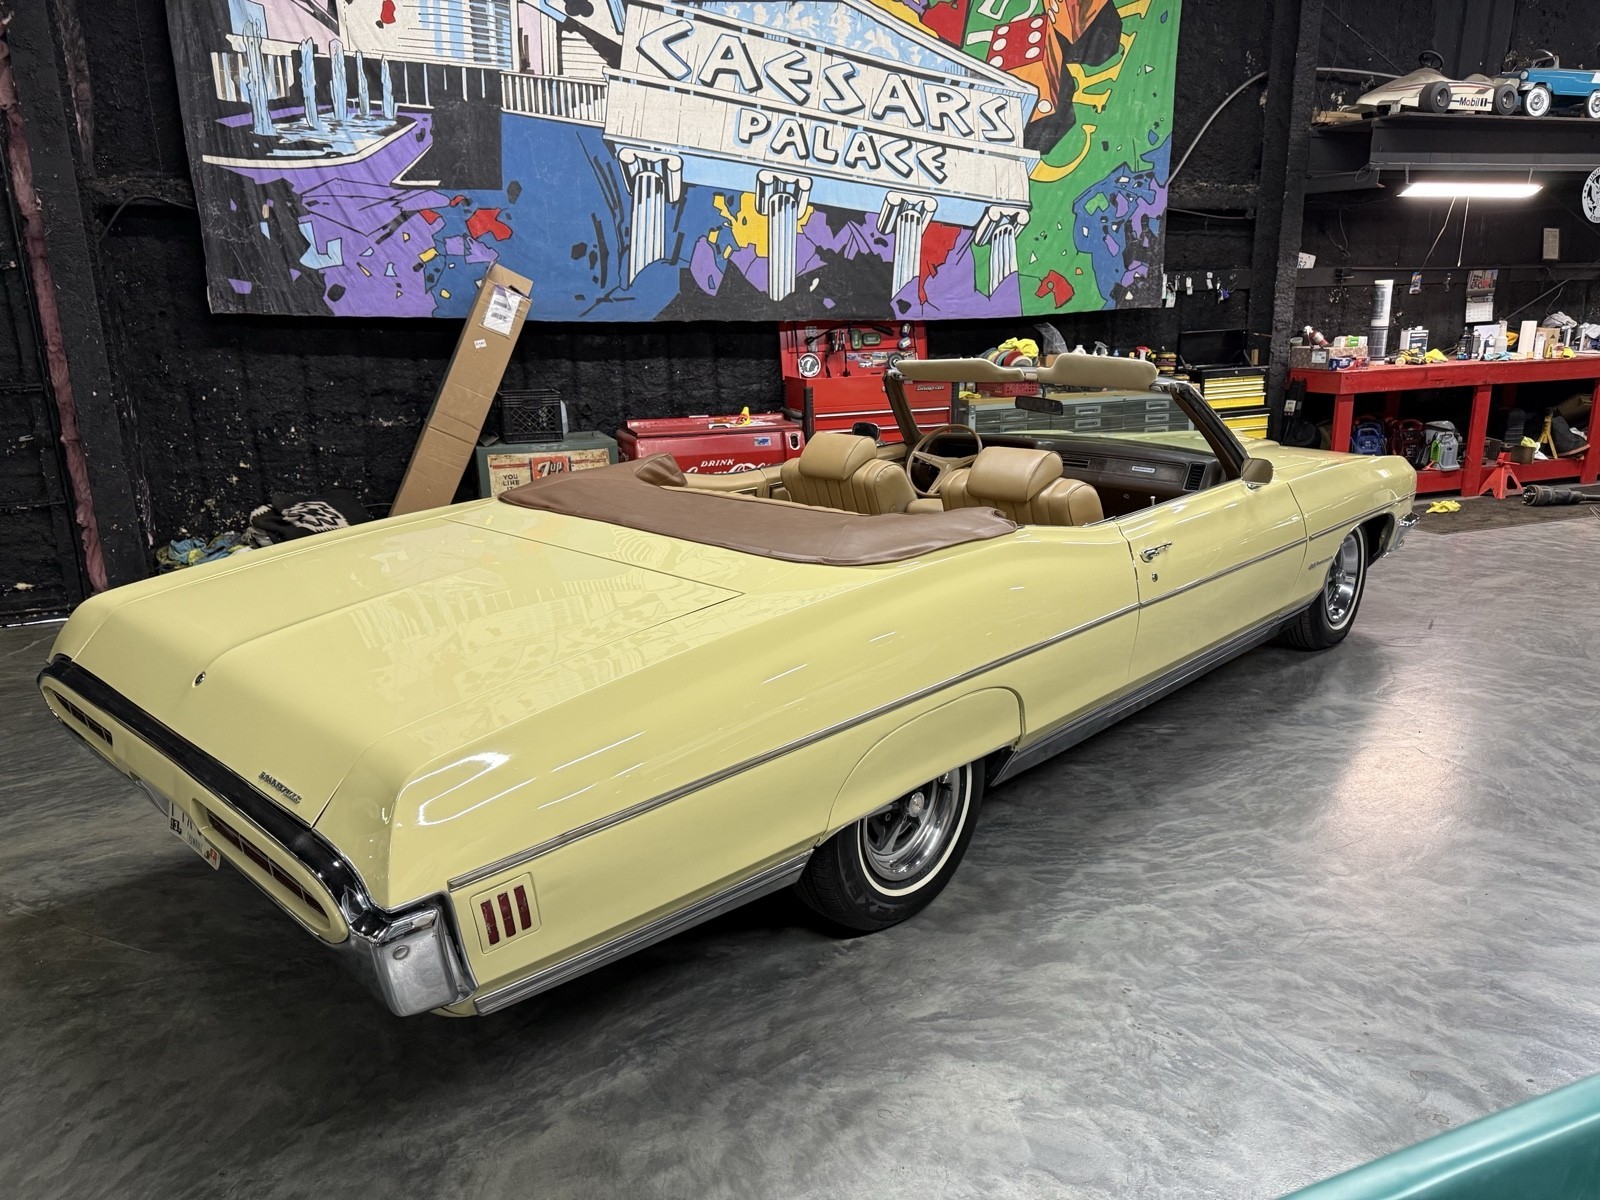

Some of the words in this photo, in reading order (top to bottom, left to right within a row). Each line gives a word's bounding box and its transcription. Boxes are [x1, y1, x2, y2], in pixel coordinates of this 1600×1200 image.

[638, 20, 1016, 142] CAESARS
[738, 108, 948, 183] PALACE
[700, 458, 735, 468] DRINK
